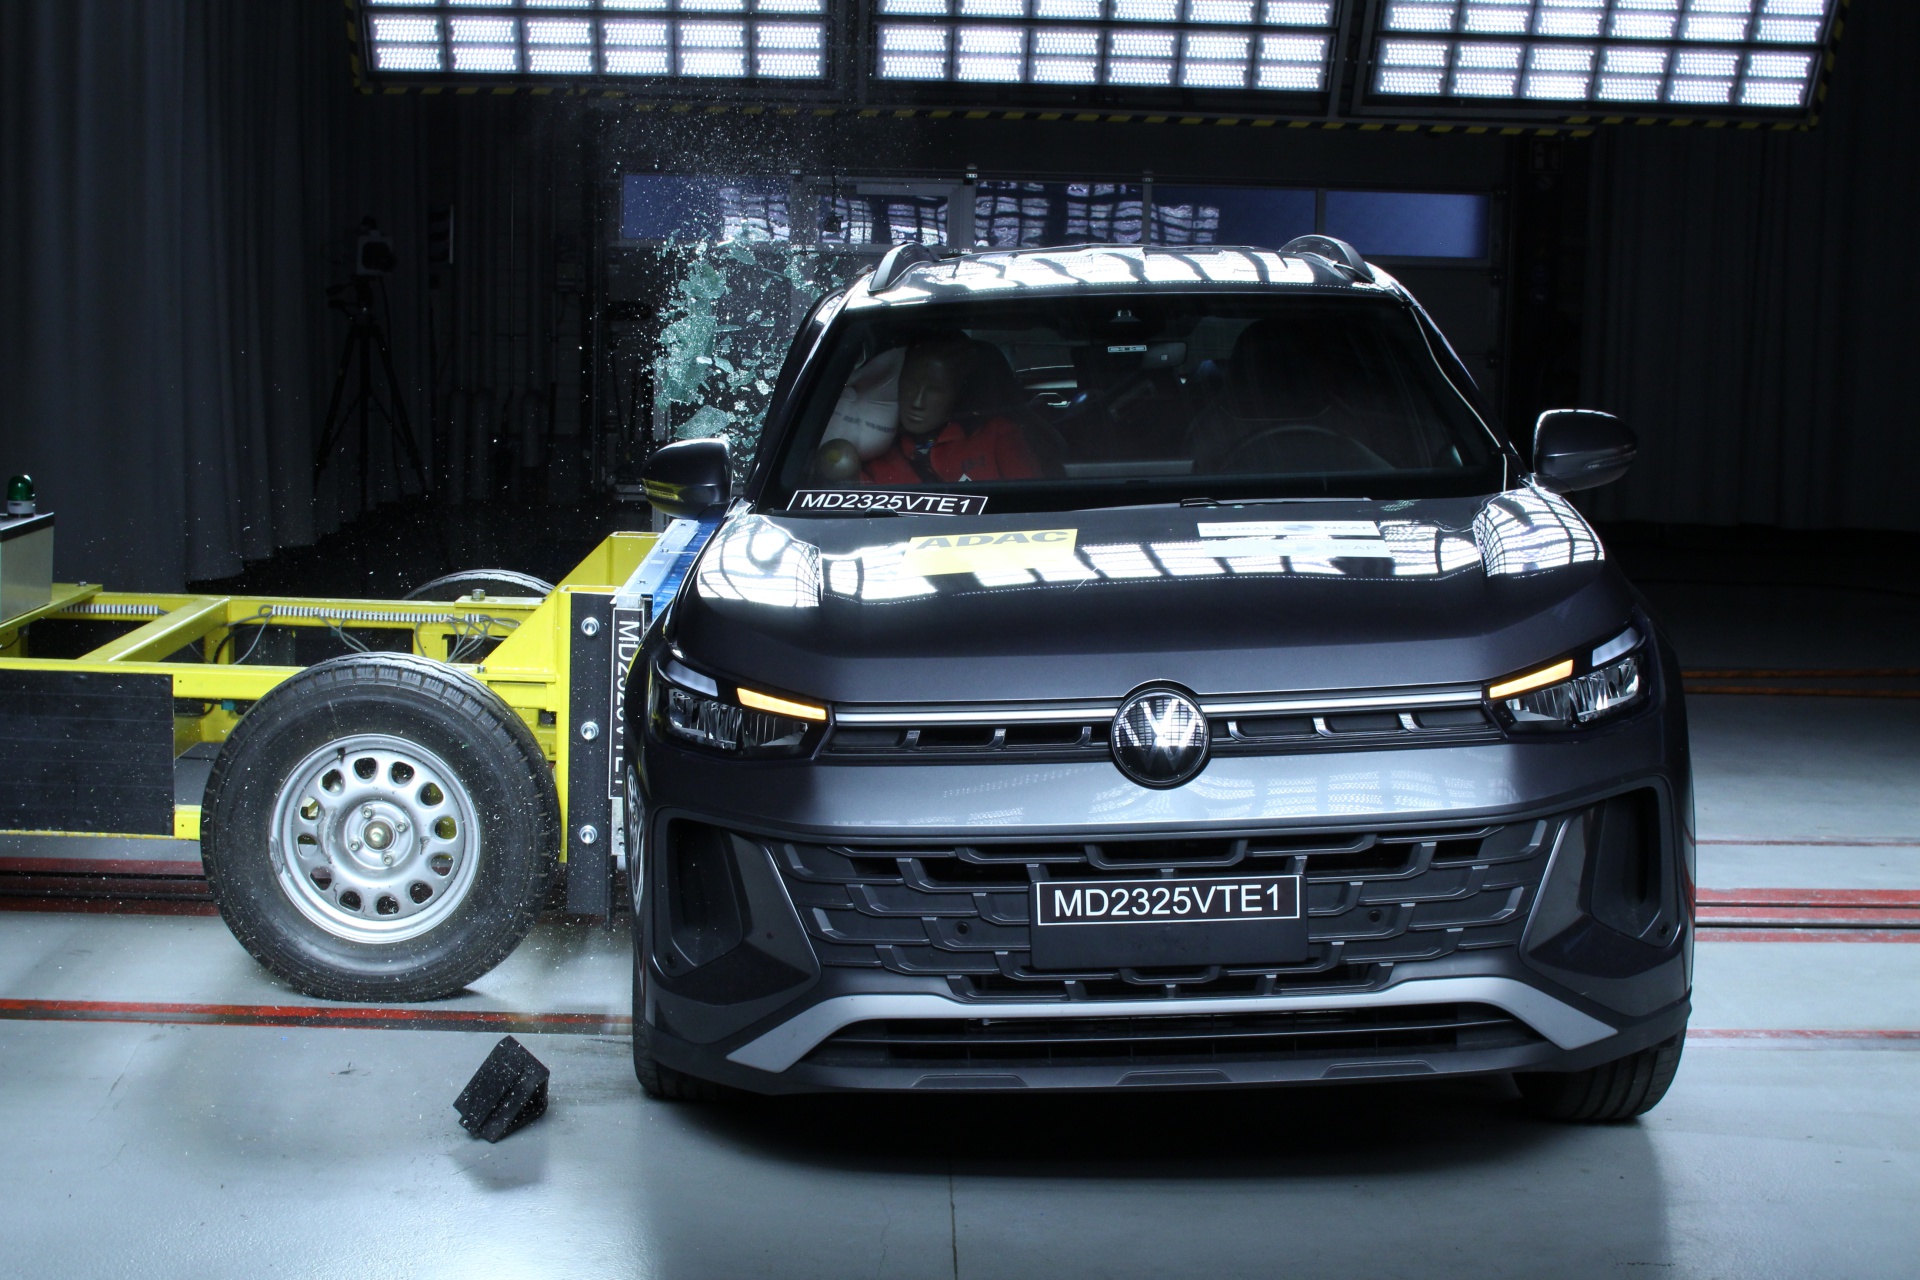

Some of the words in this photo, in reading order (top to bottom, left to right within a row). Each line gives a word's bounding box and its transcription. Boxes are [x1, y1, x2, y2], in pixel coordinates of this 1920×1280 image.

[800, 493, 971, 513] MD2325VTE1
[916, 531, 1069, 549] ADAC
[1054, 883, 1280, 917] MD2325VTE1
